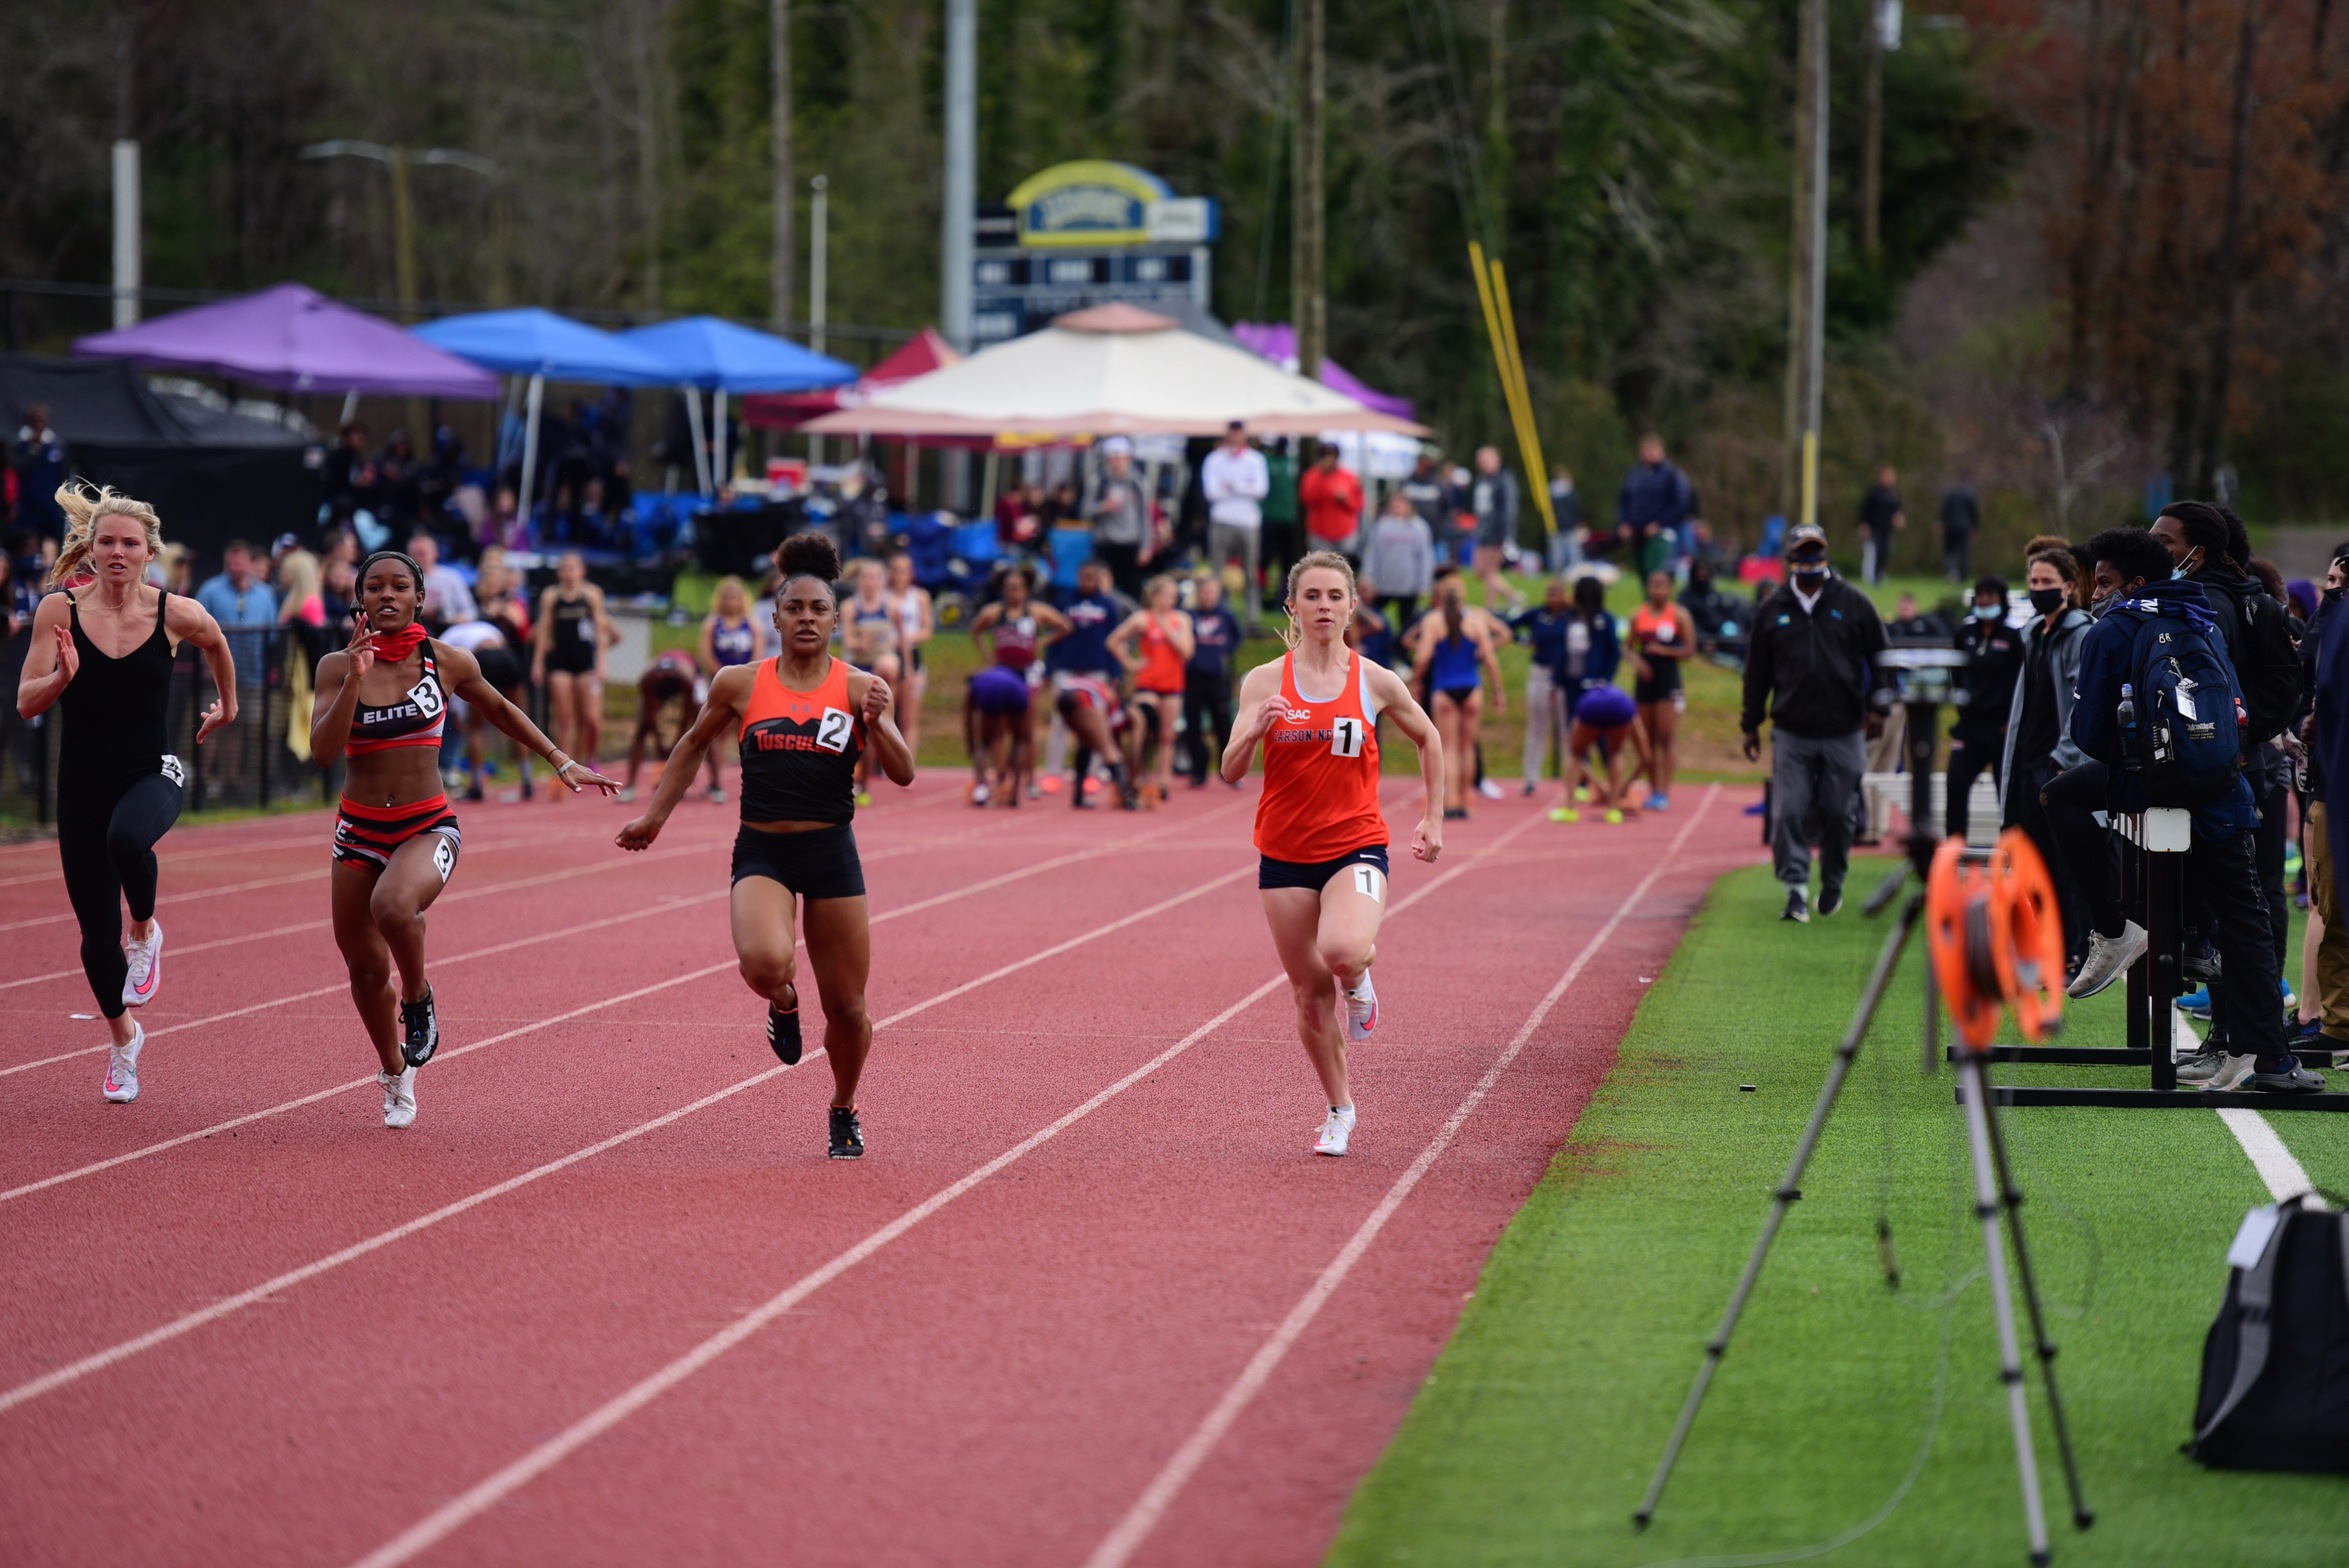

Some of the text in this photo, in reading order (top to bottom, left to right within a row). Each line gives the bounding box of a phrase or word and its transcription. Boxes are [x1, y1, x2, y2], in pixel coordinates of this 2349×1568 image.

[414, 682, 439, 713] 3
[363, 704, 418, 725] ELITE
[1287, 709, 1311, 720] SAC
[754, 729, 840, 756] TUSCUL
[821, 712, 846, 749] 2
[1339, 721, 1352, 754] 1
[436, 844, 451, 874] 3
[1359, 869, 1372, 895] 1
